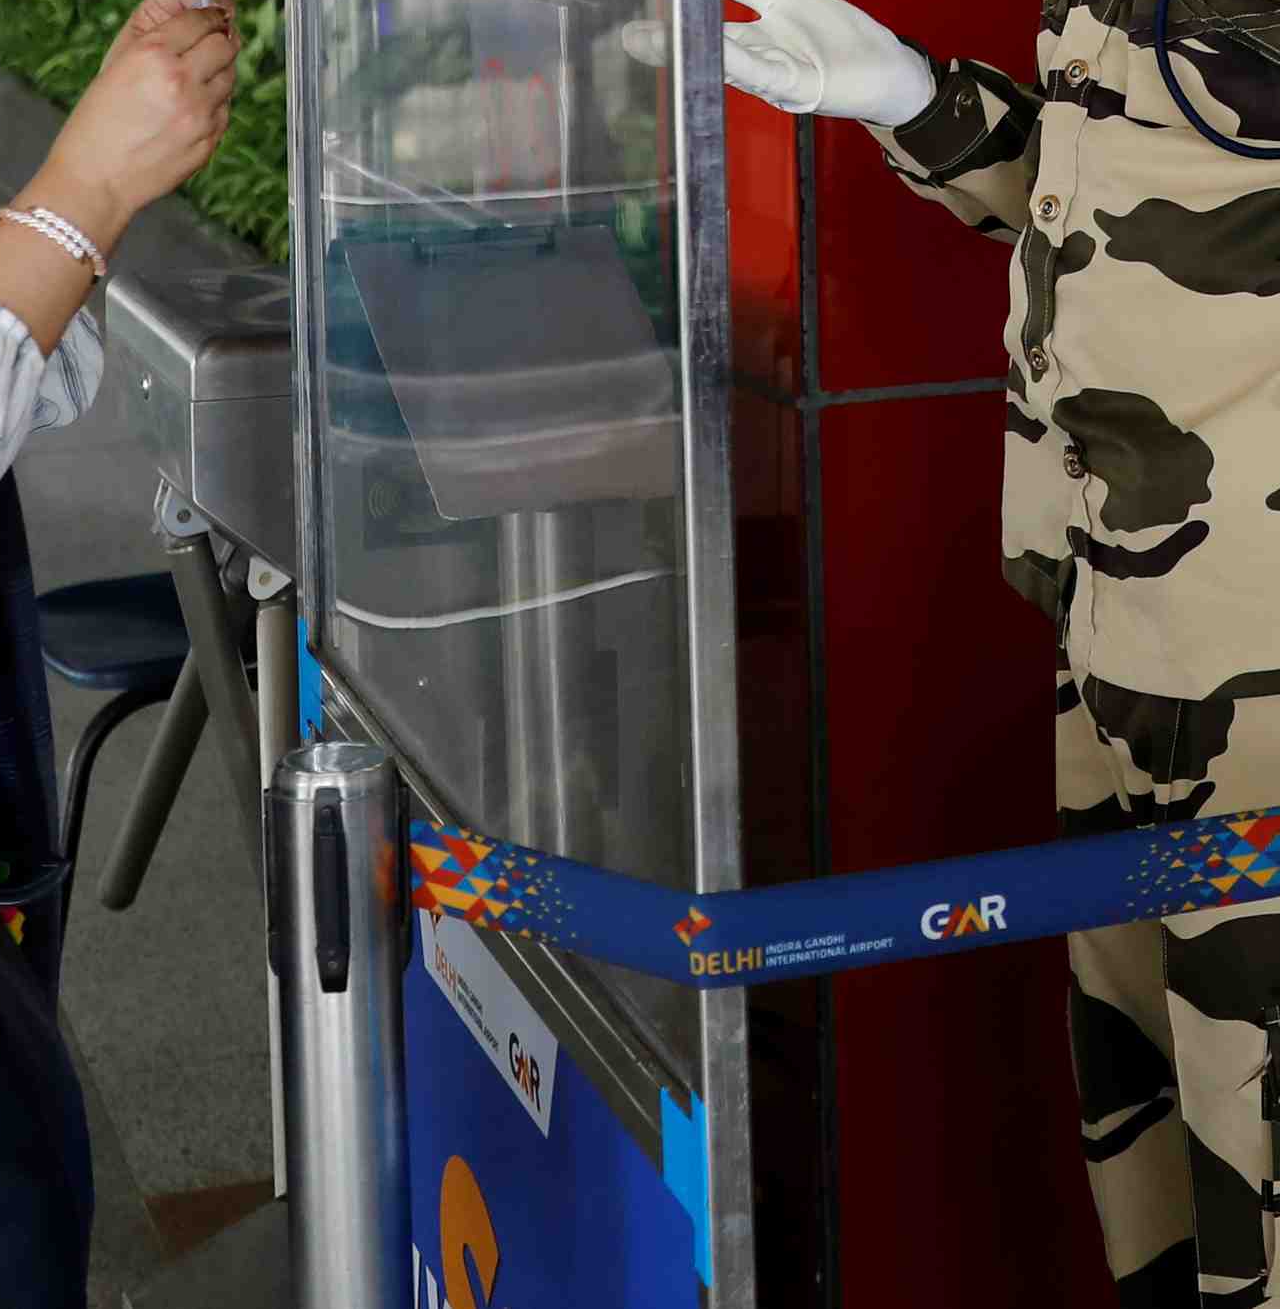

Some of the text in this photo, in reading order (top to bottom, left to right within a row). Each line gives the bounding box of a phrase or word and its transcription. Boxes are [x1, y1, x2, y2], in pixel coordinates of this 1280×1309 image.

[919, 894, 1008, 941] GMR
[766, 934, 847, 956] INDIRA GANDHI
[766, 937, 895, 968] INTERNATIONAL AIRPORT
[689, 946, 763, 976] DELHI
